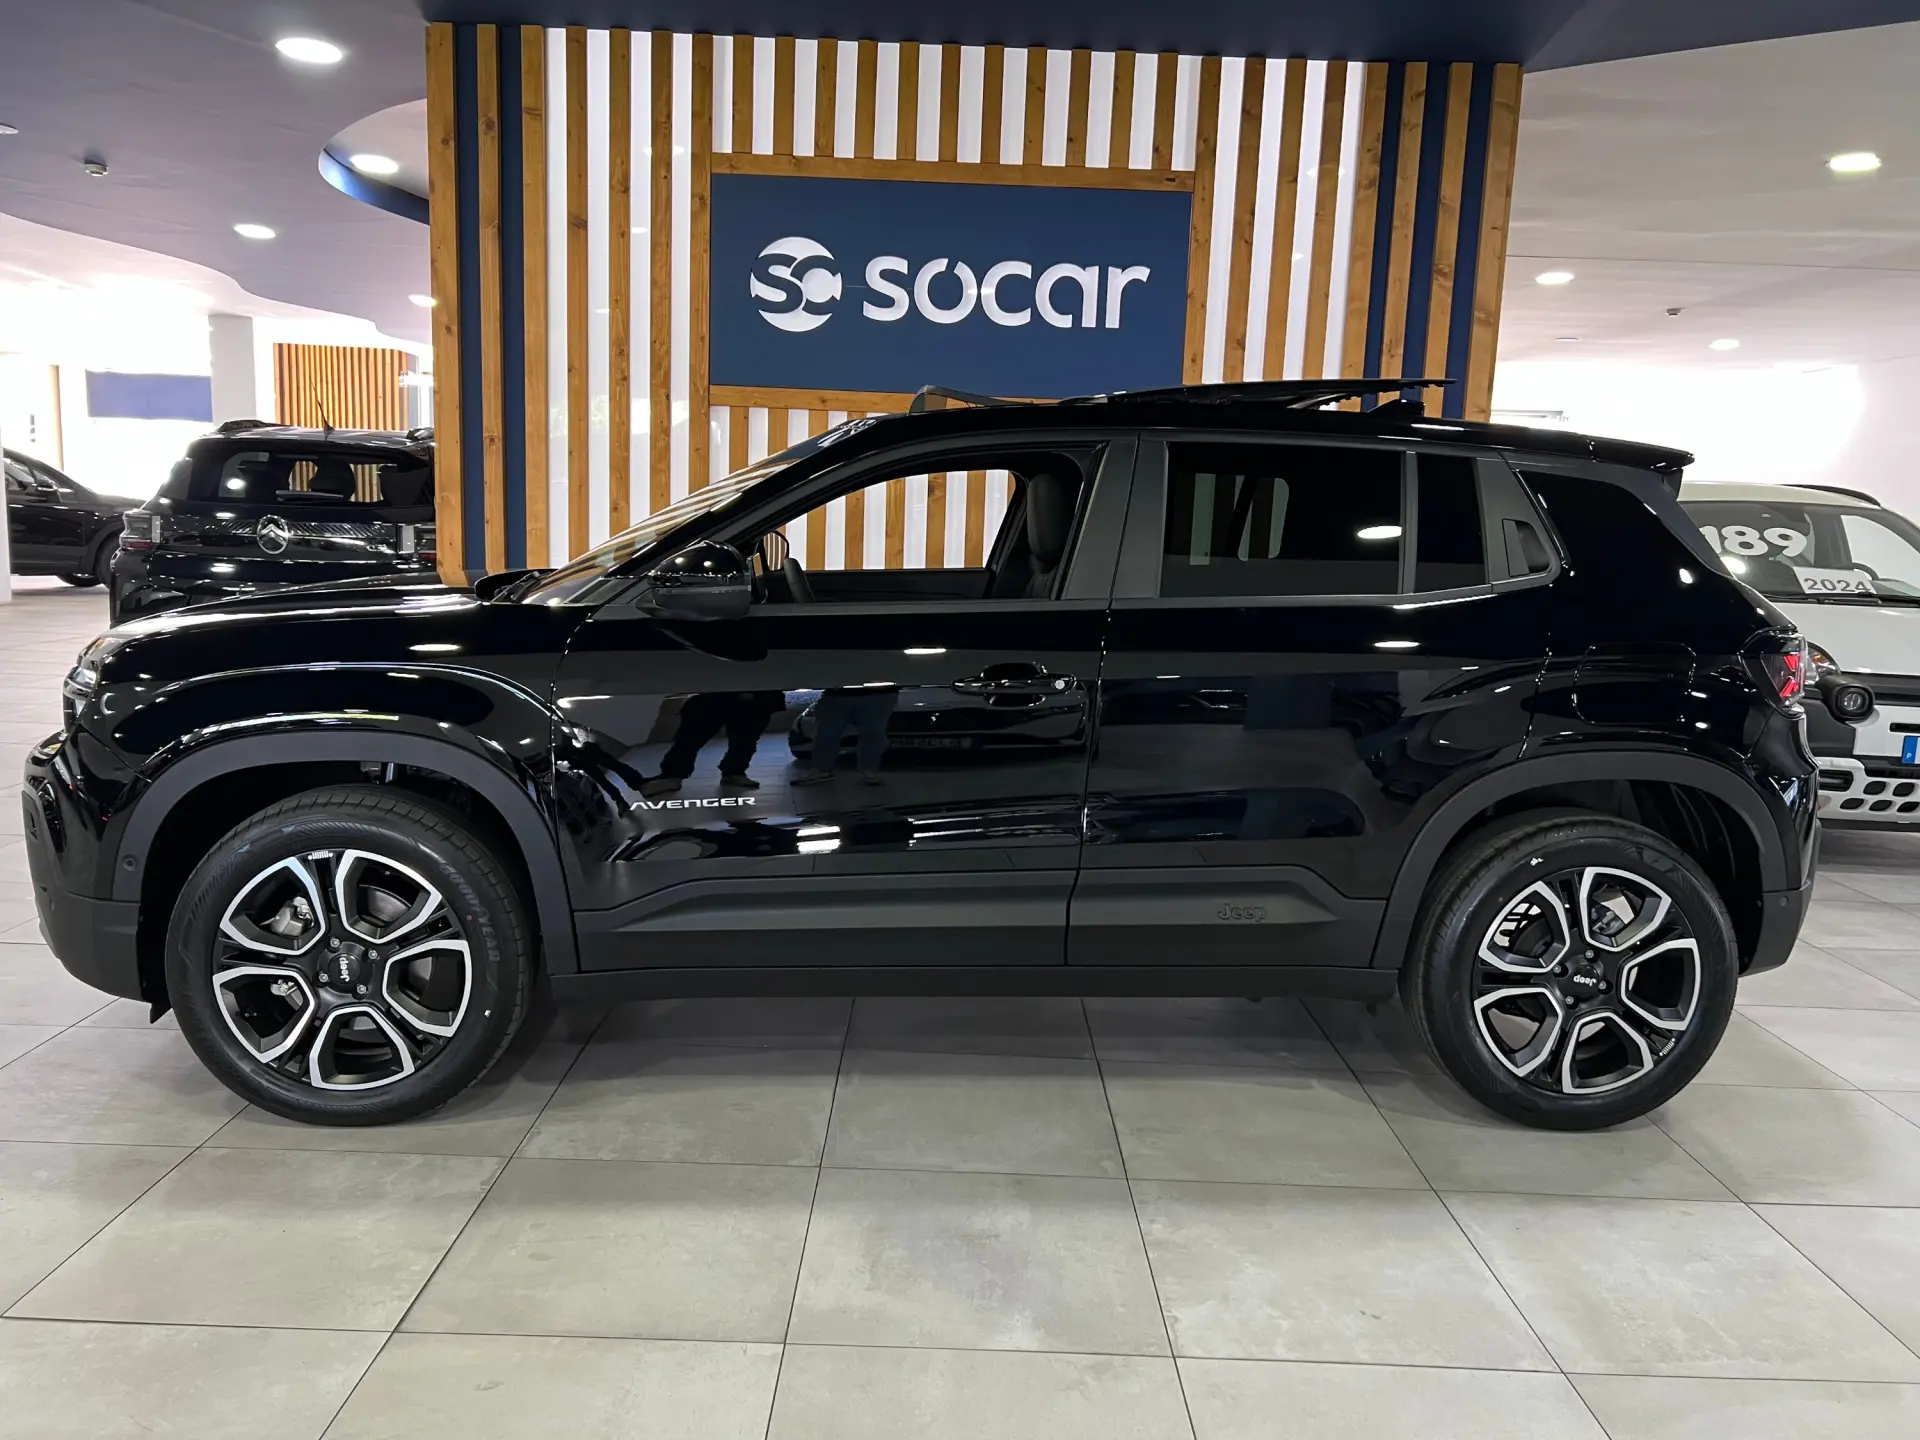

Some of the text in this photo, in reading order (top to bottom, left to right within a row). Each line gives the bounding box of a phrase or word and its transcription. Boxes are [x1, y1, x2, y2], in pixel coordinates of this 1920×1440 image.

[1803, 578, 1871, 593] 2024
[629, 796, 757, 811] AVENGER
[439, 861, 500, 962] GOODYEAR
[1217, 902, 1267, 923] Jeep
[339, 956, 351, 982] Jeep
[1573, 974, 1597, 987] Jeep
